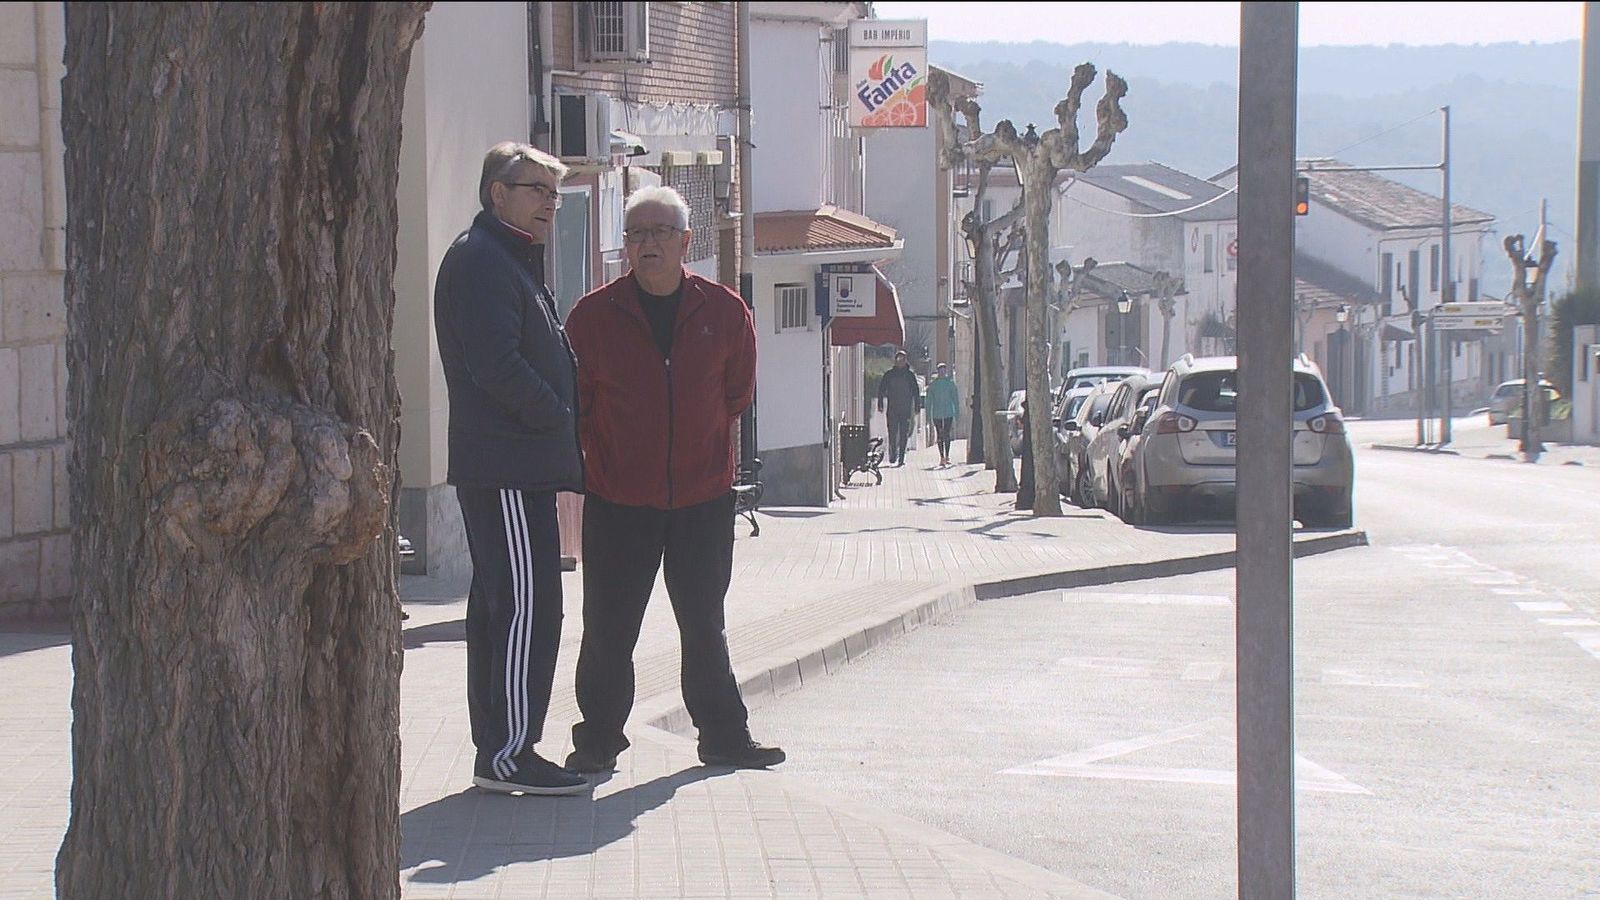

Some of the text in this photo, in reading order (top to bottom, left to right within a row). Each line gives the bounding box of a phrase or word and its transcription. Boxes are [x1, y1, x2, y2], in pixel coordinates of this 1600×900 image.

[863, 29, 911, 40] BAR IMPERIO
[857, 62, 917, 112] Fanta
